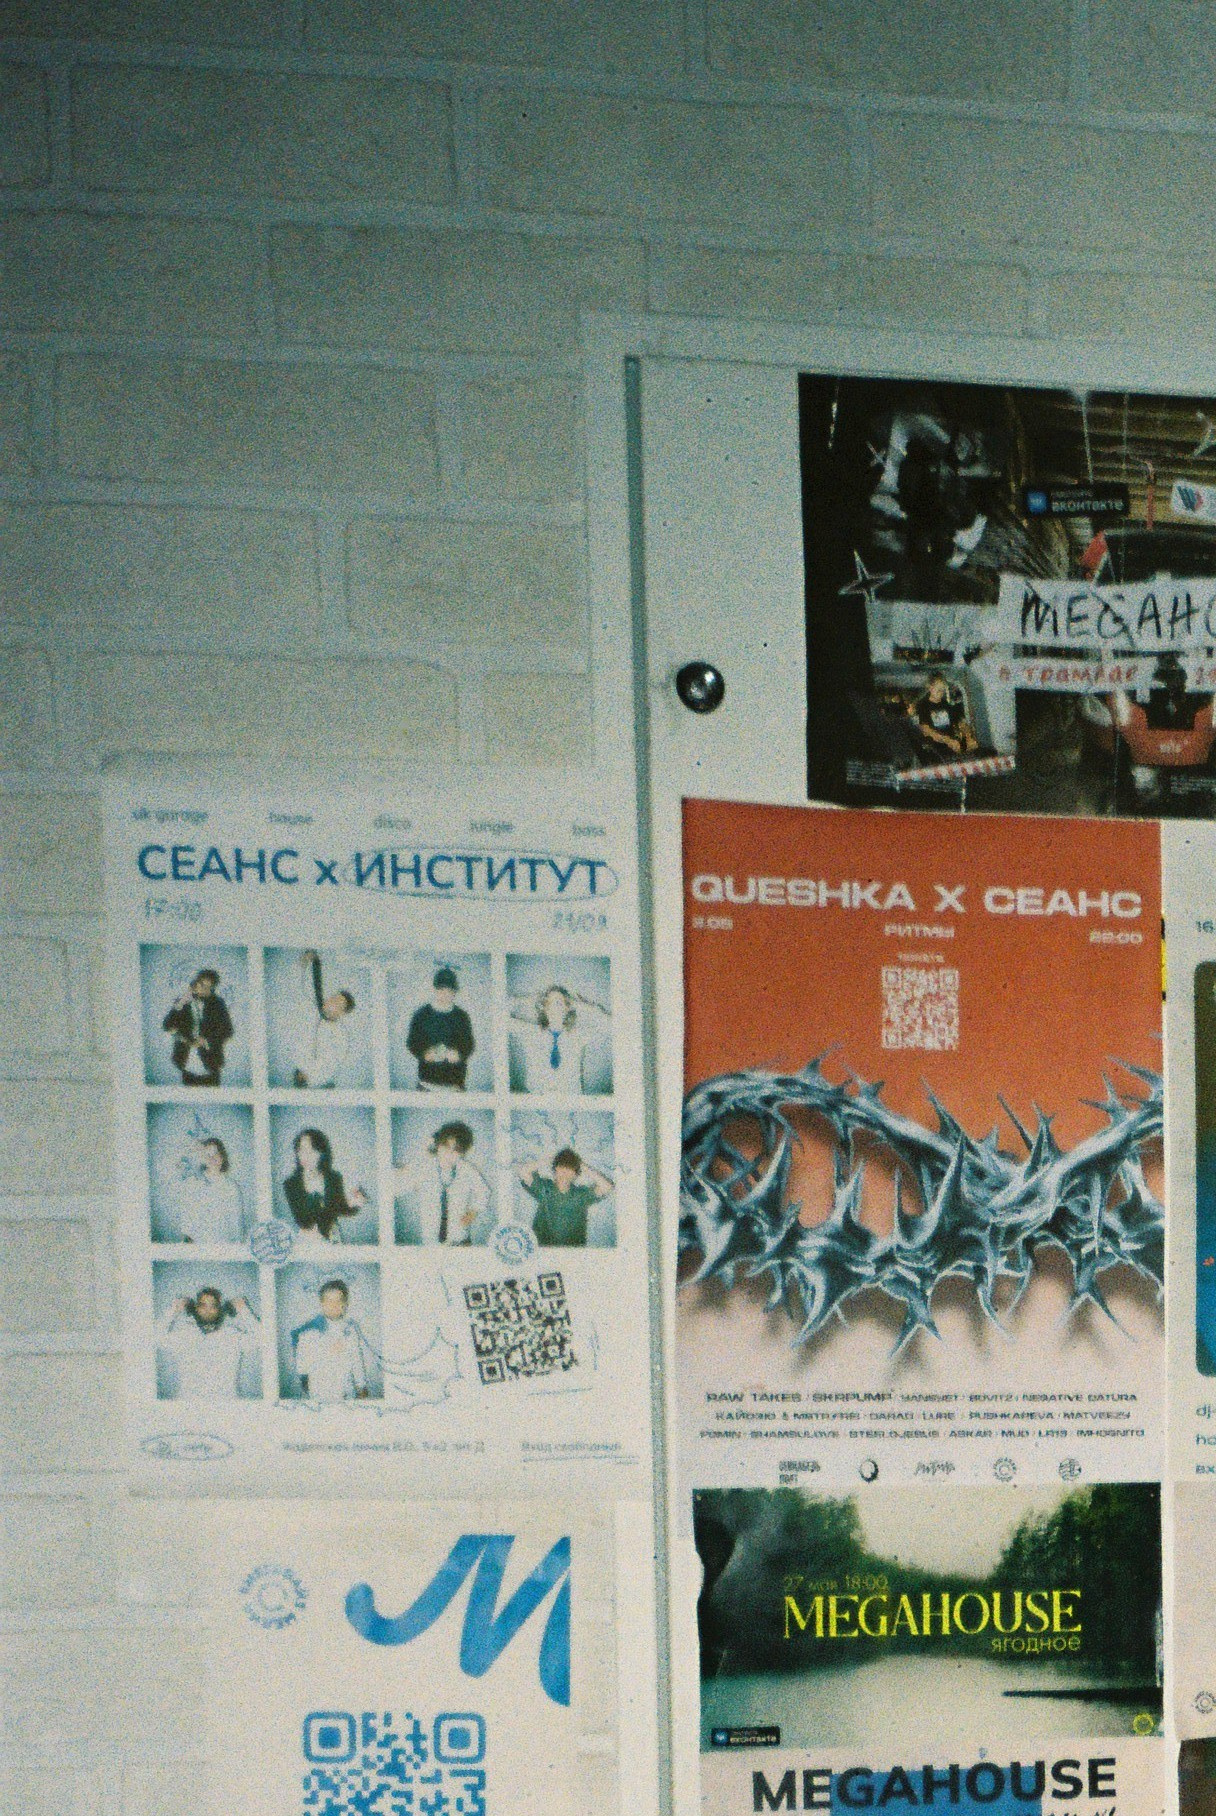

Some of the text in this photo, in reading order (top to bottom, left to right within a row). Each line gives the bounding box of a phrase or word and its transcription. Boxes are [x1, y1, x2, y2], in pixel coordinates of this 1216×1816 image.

[137, 844, 300, 885] СЕАНС
[355, 852, 607, 895] ИНСТИТУТ
[691, 873, 916, 913] QUESHKA
[984, 887, 1143, 918] СЕАНС
[783, 1589, 1082, 1640] MEGAHOUSE
[991, 1635, 1081, 1654] ягодное
[751, 1757, 1117, 1813] MEGAHOUSE
